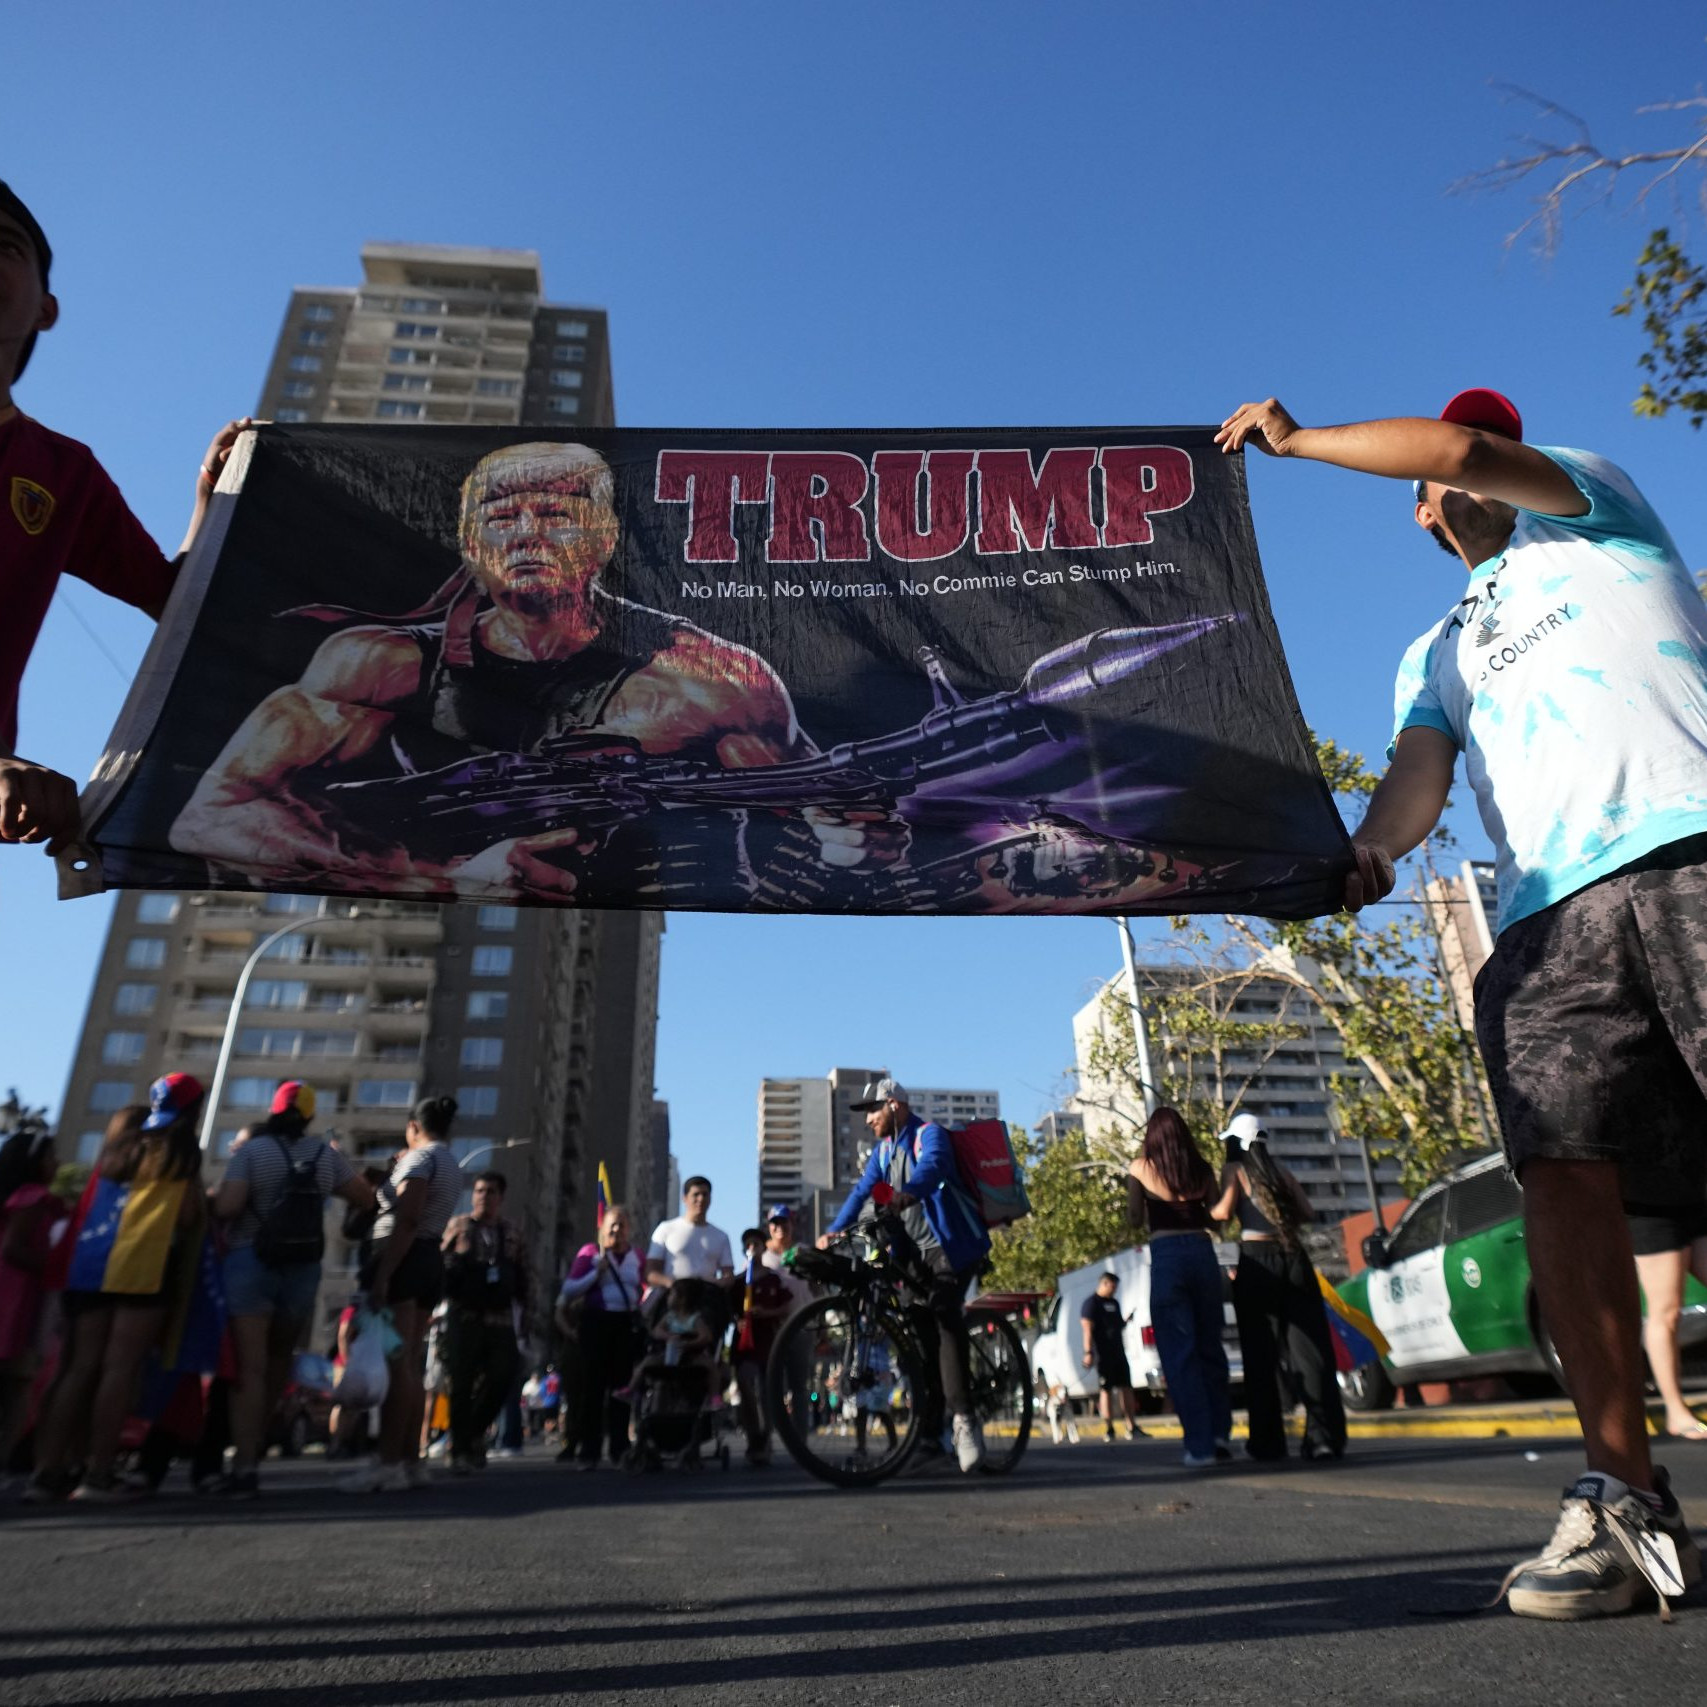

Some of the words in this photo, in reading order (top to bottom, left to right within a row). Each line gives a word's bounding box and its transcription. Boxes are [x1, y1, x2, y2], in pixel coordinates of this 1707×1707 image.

[655, 445, 1195, 563] TRUMP
[681, 581, 713, 599] No
[717, 581, 767, 600] Man,
[774, 580, 805, 598] No
[810, 580, 894, 598] Woman,
[899, 579, 929, 597] No
[933, 572, 1017, 595] Commie
[1022, 569, 1064, 586] Can
[1069, 564, 1132, 583] Stump
[1136, 561, 1182, 577] Him.
[1488, 602, 1573, 672] COUNTRY
